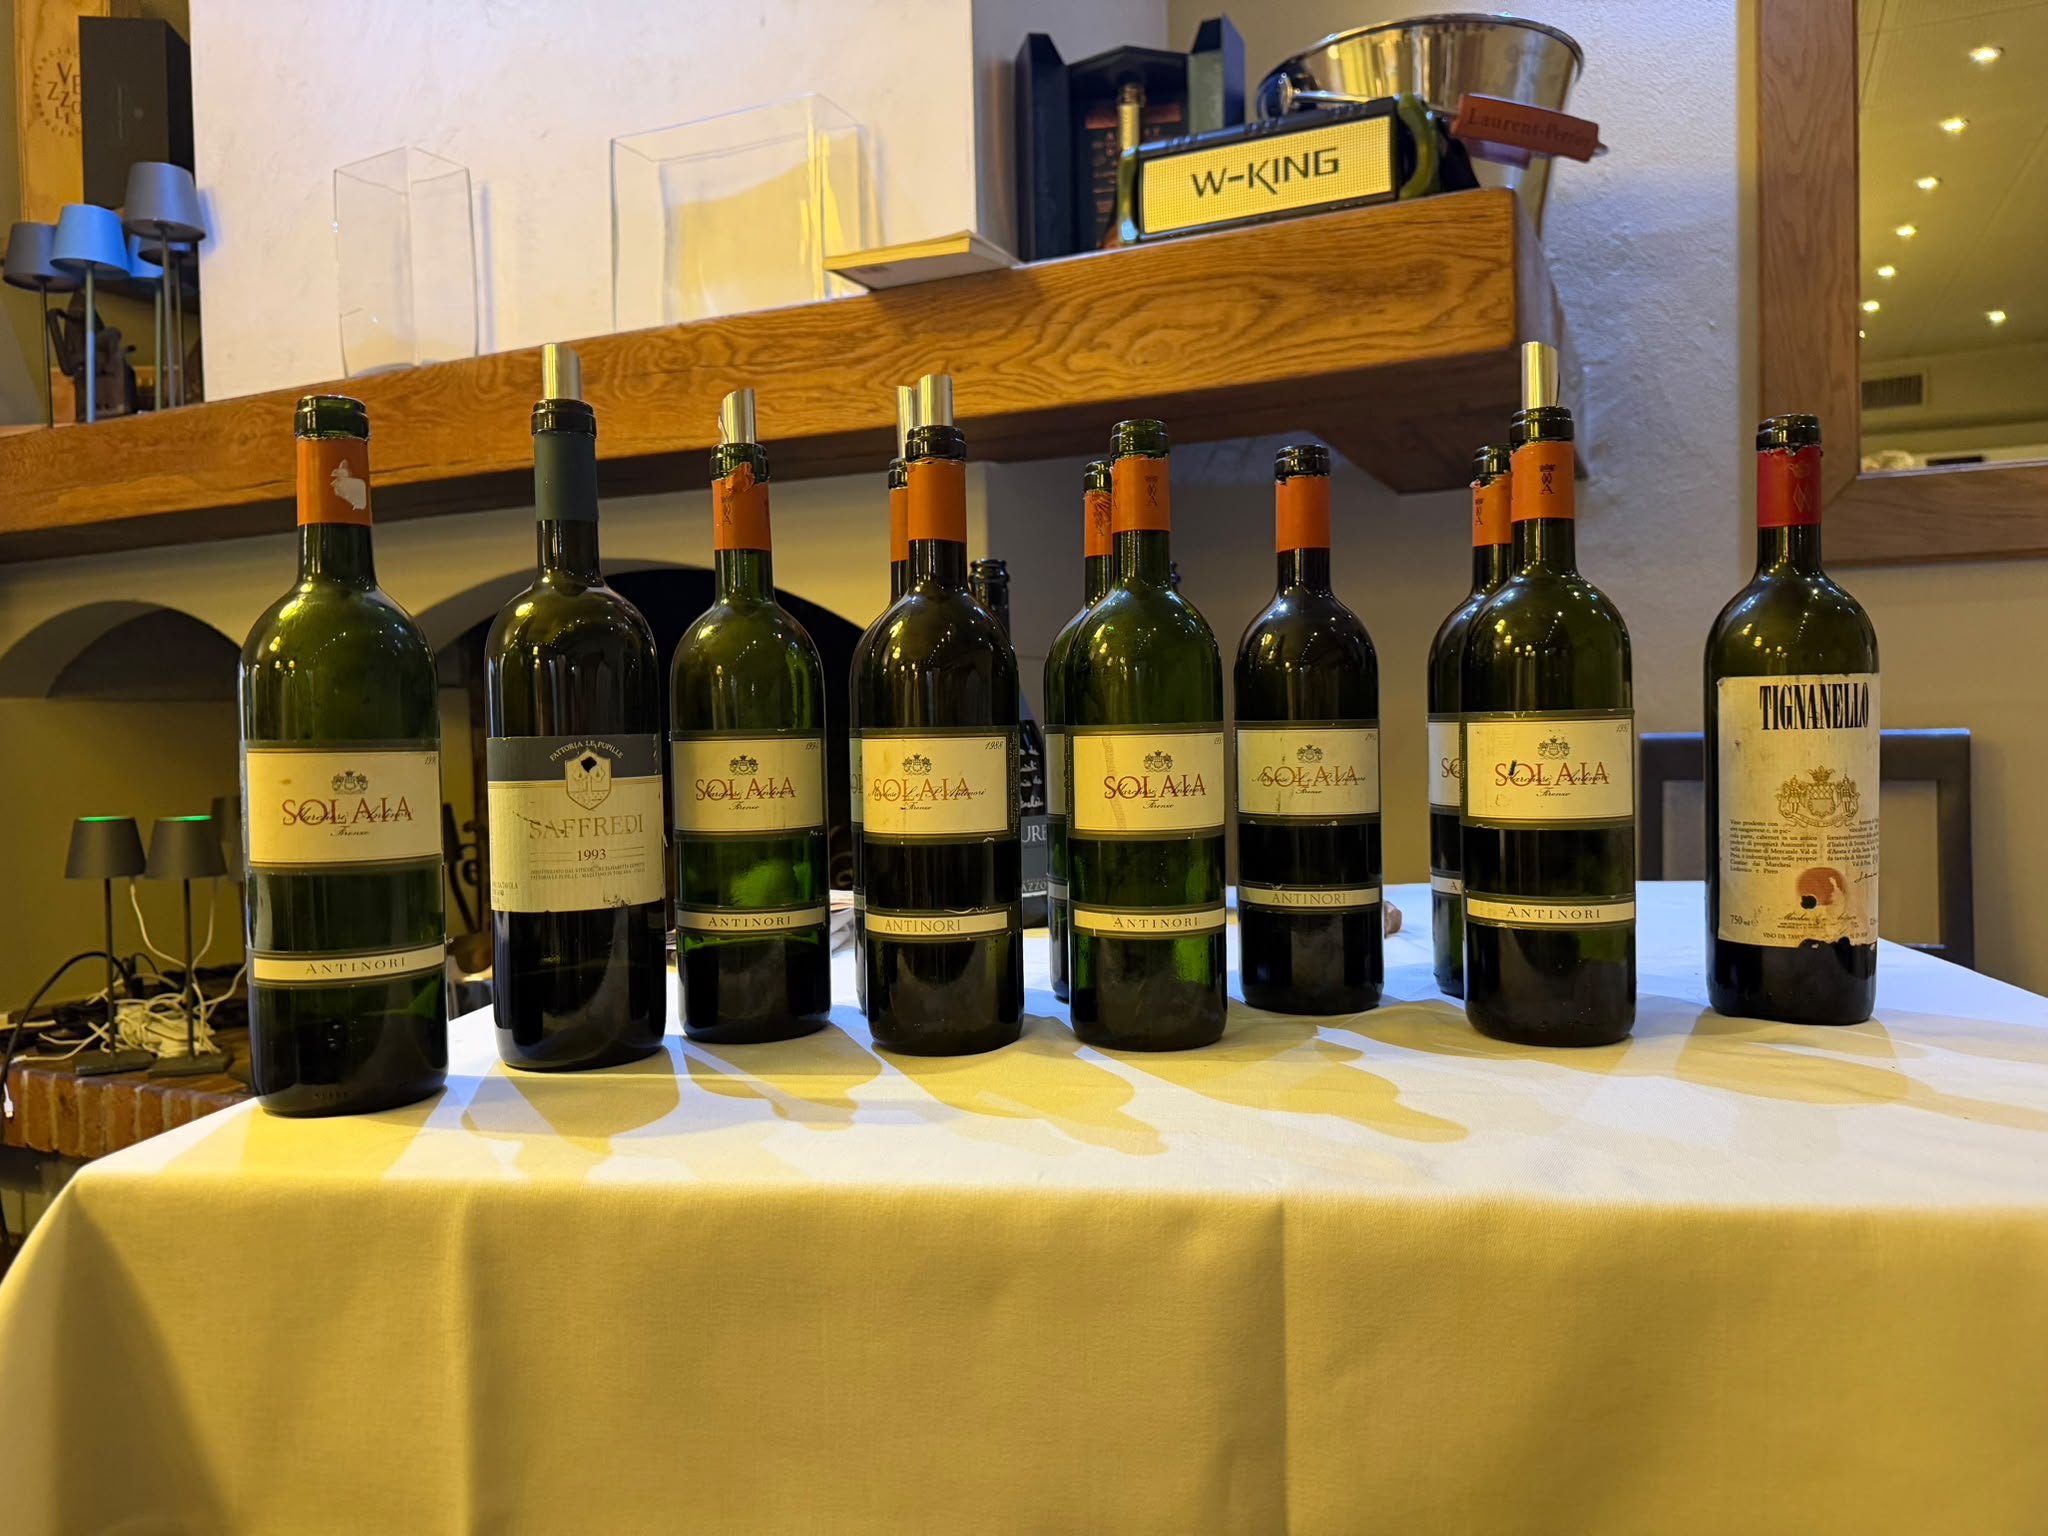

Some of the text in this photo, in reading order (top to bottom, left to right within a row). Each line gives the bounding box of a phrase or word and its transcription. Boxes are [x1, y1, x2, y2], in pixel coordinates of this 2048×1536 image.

[1191, 147, 1339, 198] W-KING
[1760, 683, 1869, 730] TIGNANELLO
[550, 742, 583, 761] FATTORIA
[597, 741, 624, 759] PUPILLE
[985, 741, 1003, 750] 1988
[1262, 765, 1359, 787] SOLAIA
[1495, 762, 1610, 787] SOLAIA
[696, 777, 796, 801] SOLAIA
[874, 778, 972, 802] SOLAIA
[1104, 773, 1207, 799] SOLAIA
[282, 795, 414, 827] SOLAIA
[529, 814, 643, 839] SAFFREDI
[577, 849, 607, 861] 1993
[1272, 893, 1346, 904] ANTINORI
[708, 915, 791, 927] ANTINORI
[1506, 906, 1600, 919] ANTINORI
[1730, 915, 1743, 925] 750
[885, 919, 960, 932] ANTINORI
[1112, 917, 1199, 929] ANTINORI
[305, 957, 406, 976] ANTINORI
